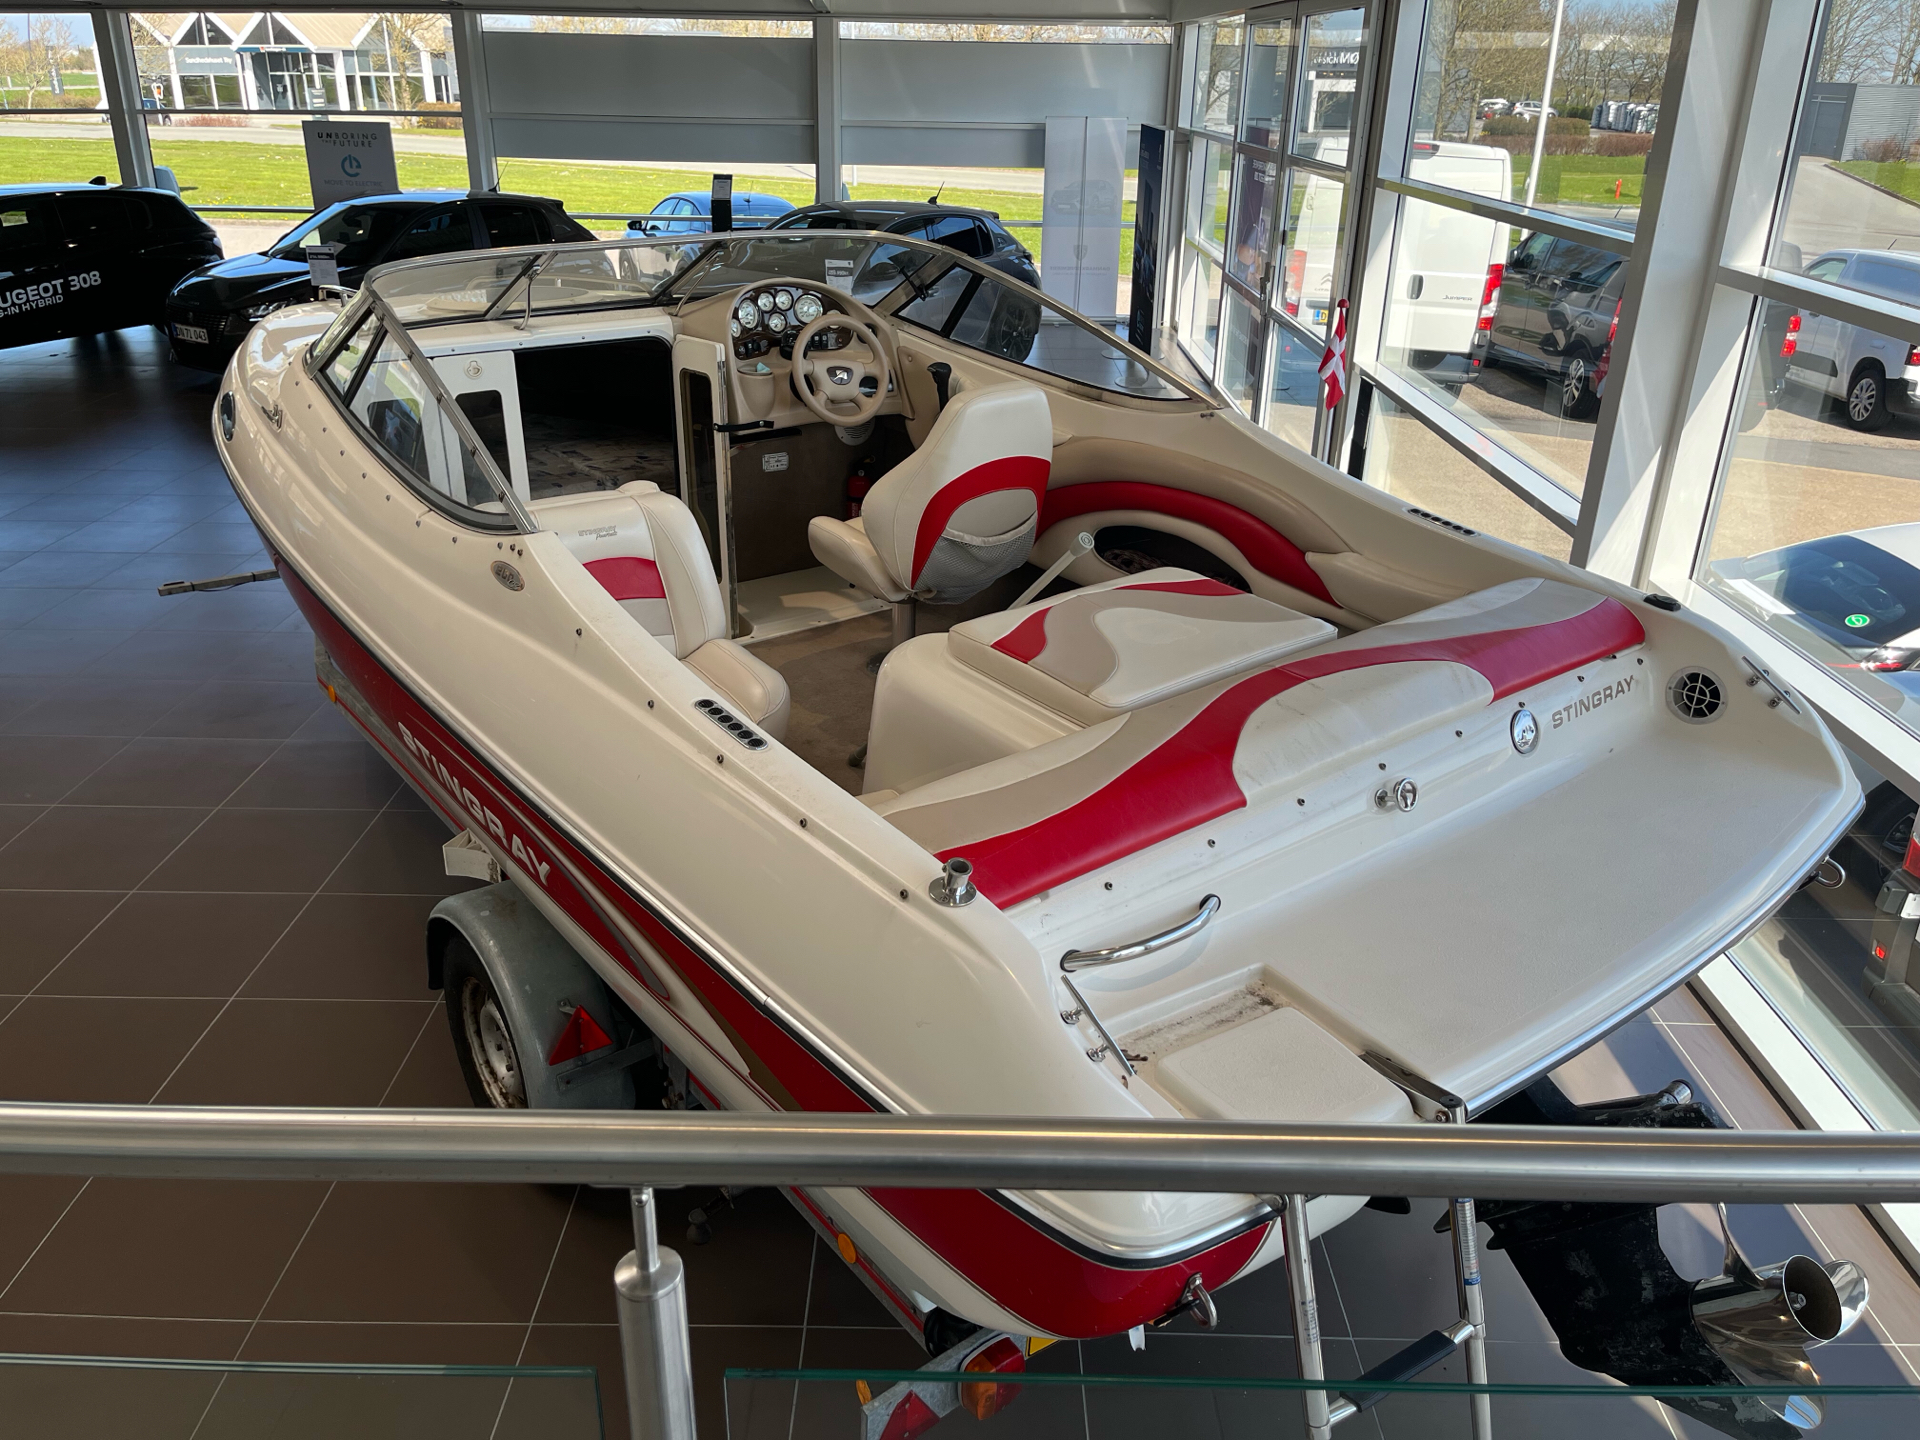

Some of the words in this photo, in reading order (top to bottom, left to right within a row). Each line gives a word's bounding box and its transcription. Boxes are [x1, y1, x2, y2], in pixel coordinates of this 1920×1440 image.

[317, 131, 378, 140] UNBORING
[333, 140, 372, 148] FUTURE
[323, 179, 344, 187] MOVE
[355, 180, 384, 188] ELECTRIC
[68, 270, 101, 291] 308
[22, 294, 64, 312] HYBRID
[1551, 674, 1634, 730] STINGRAY
[397, 721, 551, 887] STINGRAY
